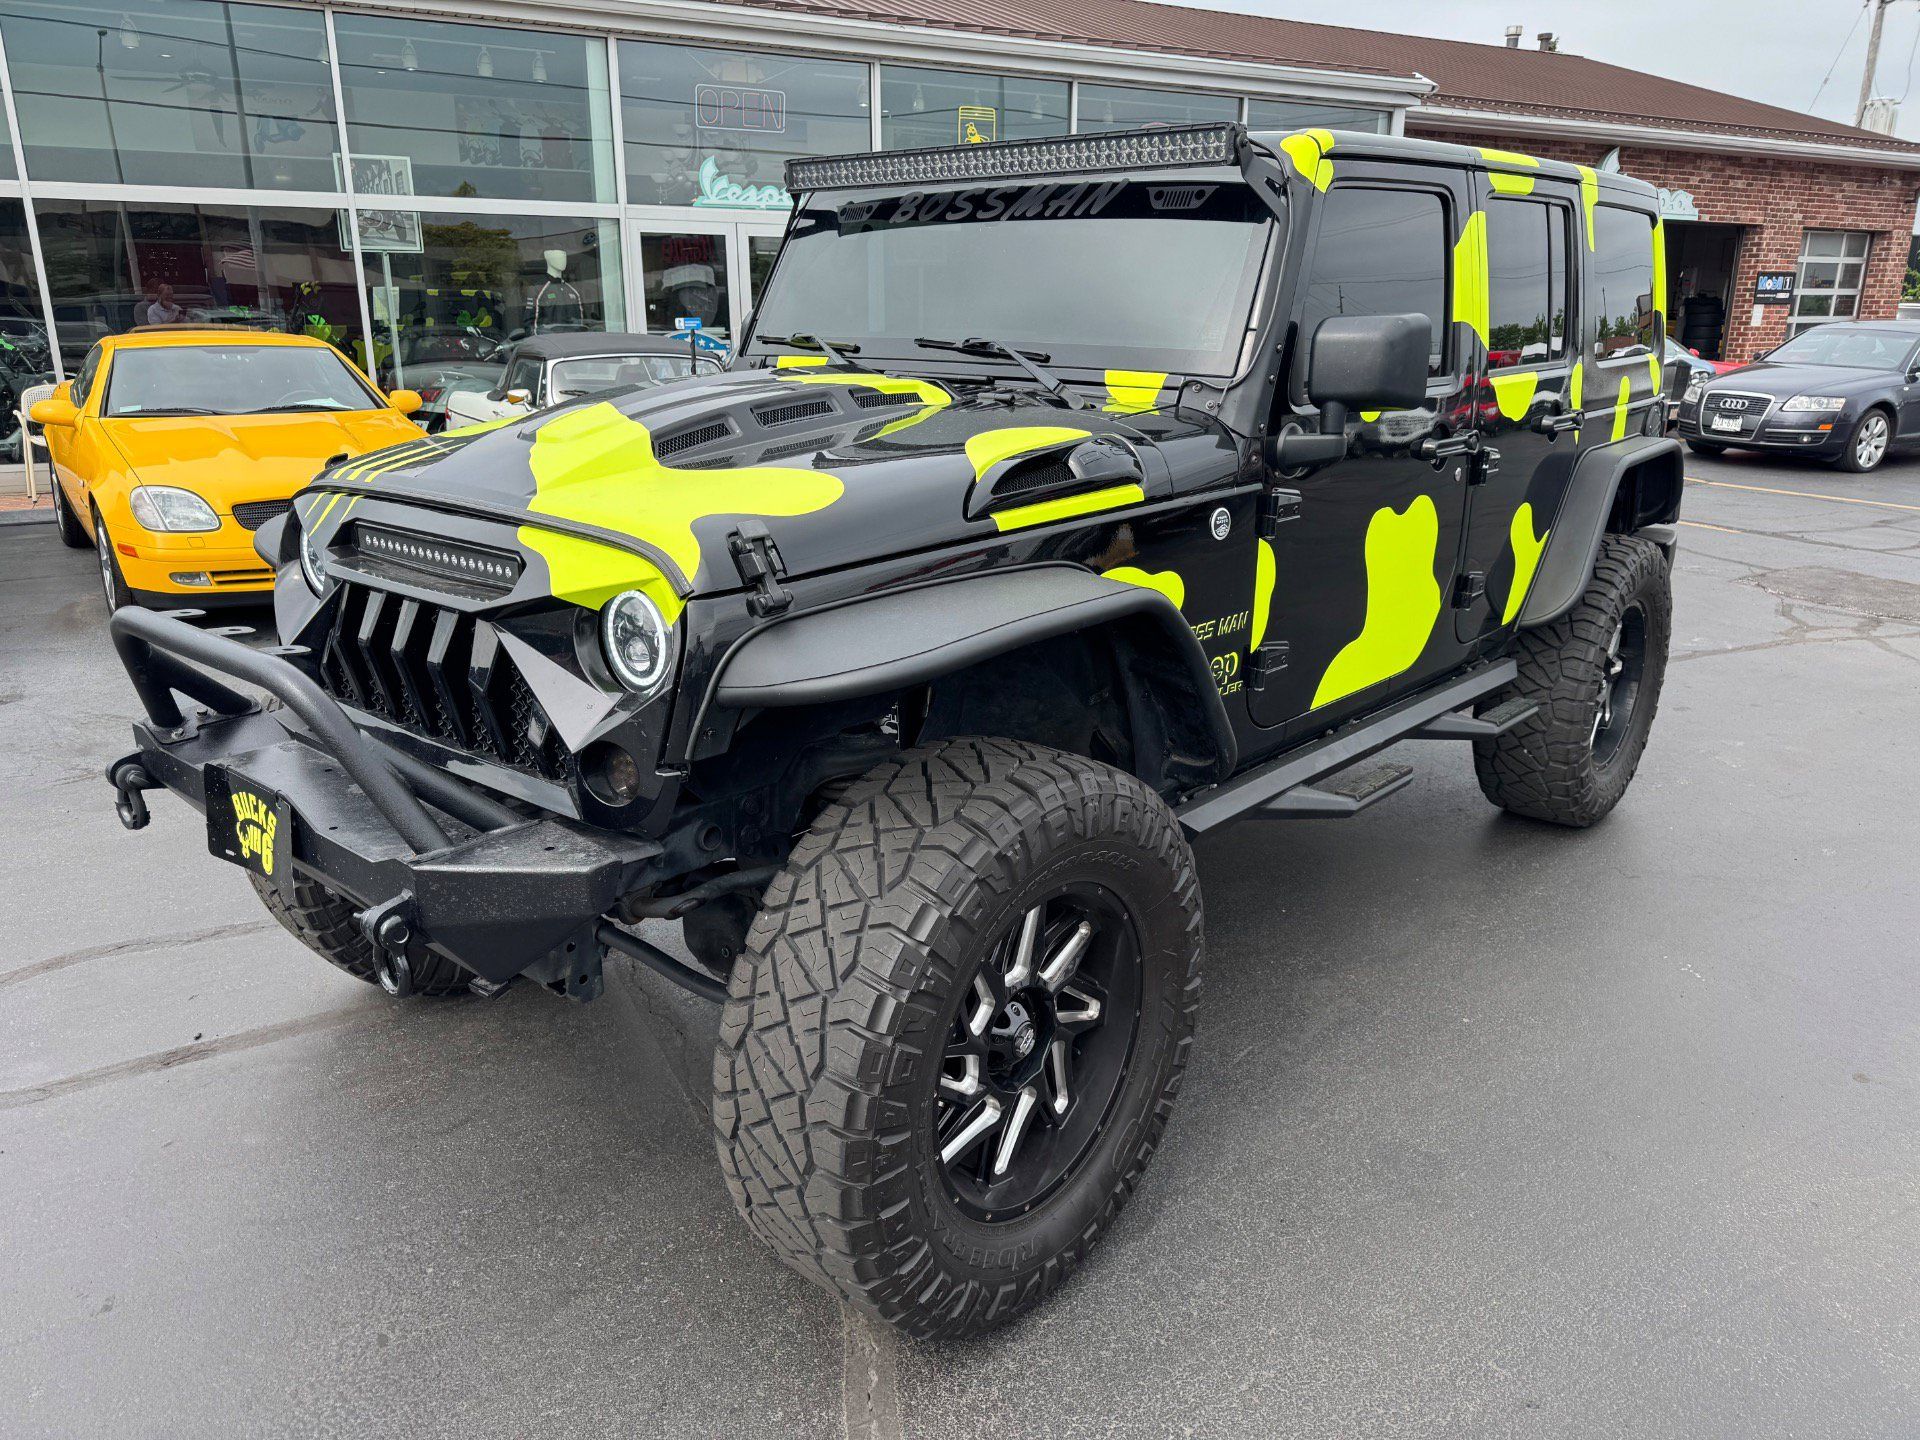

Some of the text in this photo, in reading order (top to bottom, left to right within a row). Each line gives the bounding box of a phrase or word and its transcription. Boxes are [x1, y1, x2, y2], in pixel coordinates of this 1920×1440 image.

[700, 89, 782, 129] OPEN
[889, 178, 1130, 224] BOSSMAN
[1217, 611, 1249, 636] MAN
[231, 791, 277, 840] BUCKS
